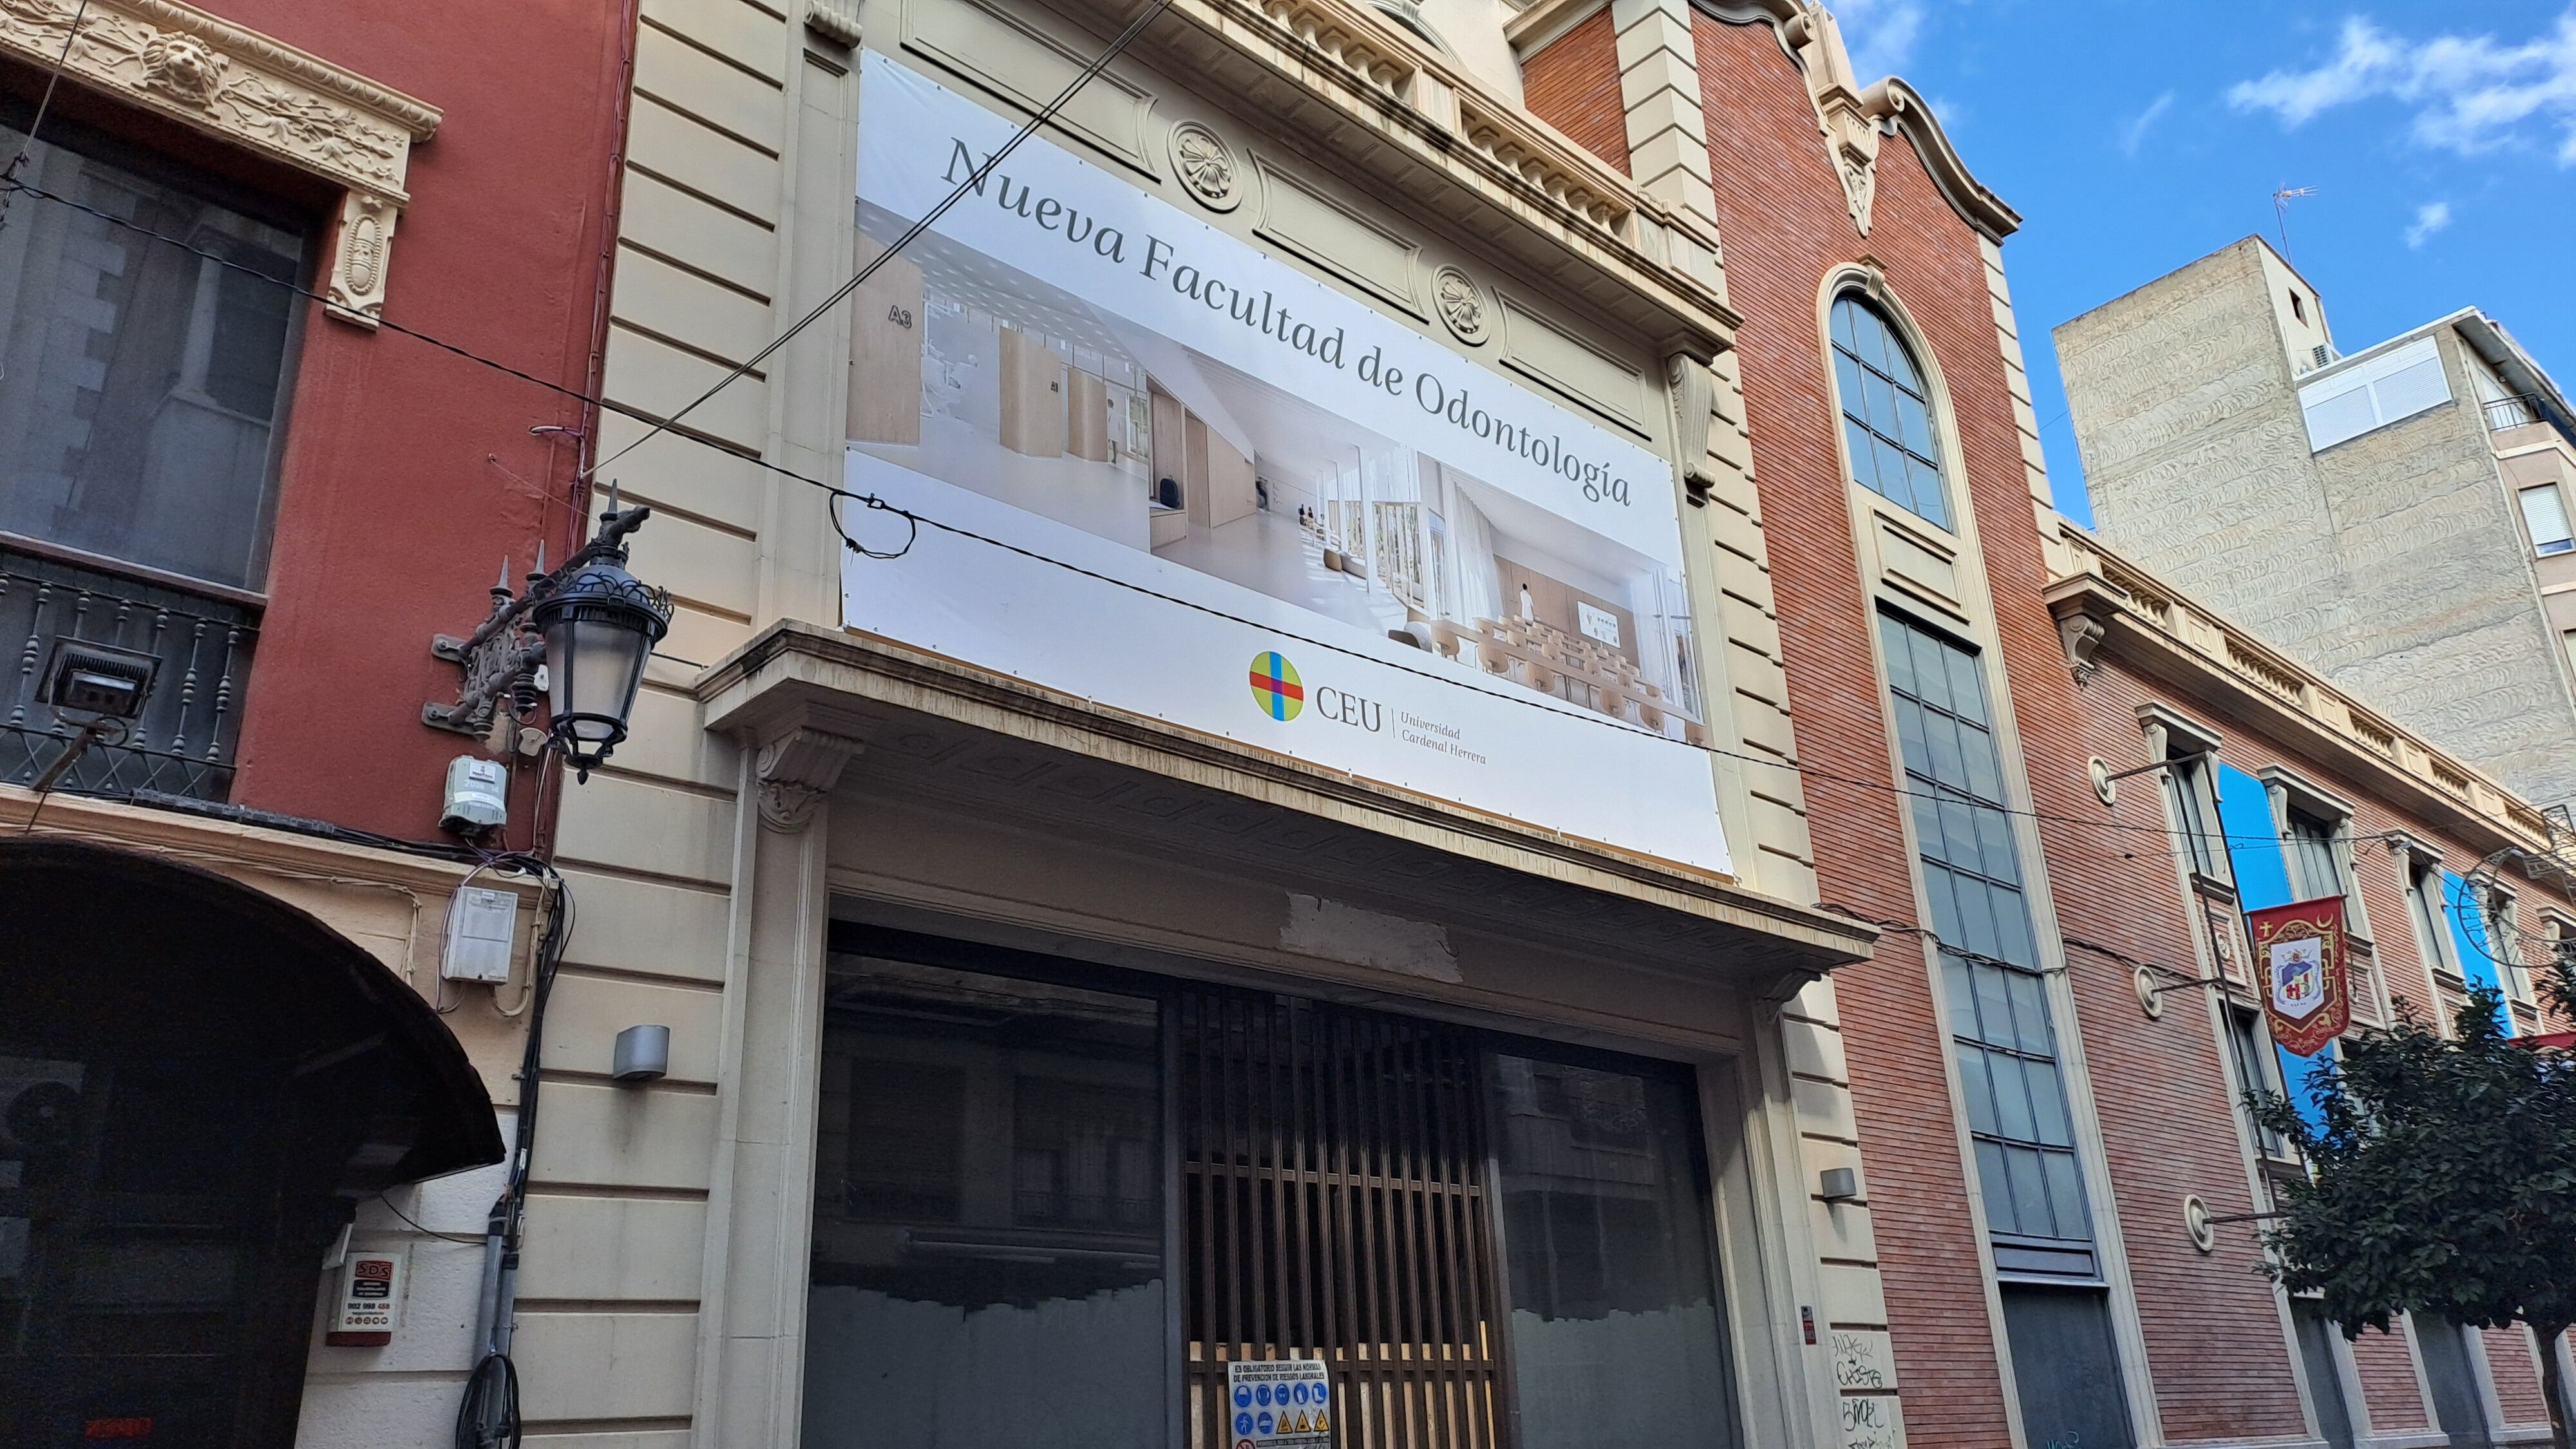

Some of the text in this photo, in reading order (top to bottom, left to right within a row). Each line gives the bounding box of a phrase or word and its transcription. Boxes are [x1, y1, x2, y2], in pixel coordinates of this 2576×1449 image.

[888, 305, 912, 329] A3
[940, 136, 1631, 507] Nueva Facultad de Odontología
[1316, 686, 1382, 733] CEU
[1400, 711, 1461, 741] Universidad
[1402, 729, 1487, 765] Cardenal Herrera
[357, 1263, 390, 1278] SDS
[1235, 1365, 1242, 1373] ES
[1244, 1364, 1275, 1373] OBLIGATORIO
[1276, 1363, 1293, 1372] SEGUIR
[1300, 1372, 1325, 1380] LABORALES
